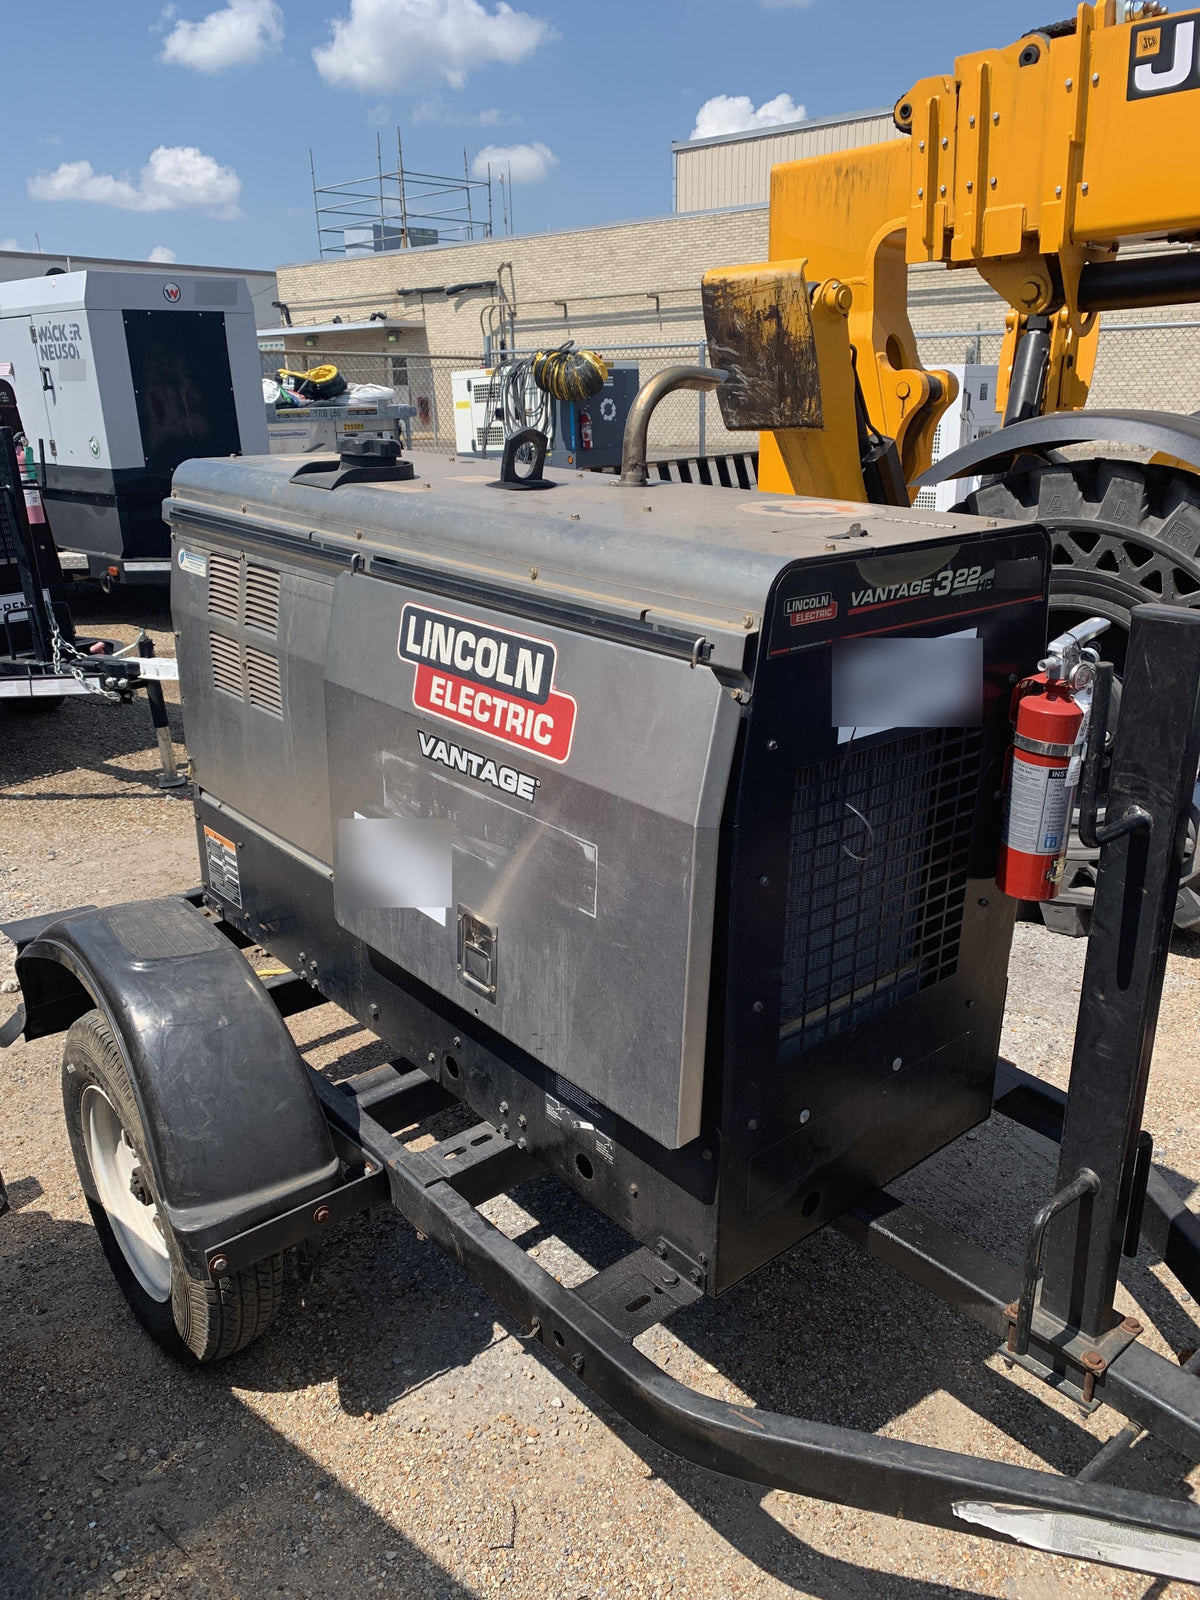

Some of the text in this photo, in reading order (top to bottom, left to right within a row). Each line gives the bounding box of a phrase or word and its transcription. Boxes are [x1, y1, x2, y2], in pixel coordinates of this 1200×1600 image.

[1133, 20, 1200, 91] J
[786, 596, 830, 613] LINCOLN
[795, 608, 833, 623] ELECTRIC
[850, 578, 933, 606] VANTAGE
[933, 565, 982, 597] 322
[405, 614, 545, 695] LINCOLN
[429, 674, 555, 746] ELECTRIC
[417, 730, 540, 803] VANTAGE
